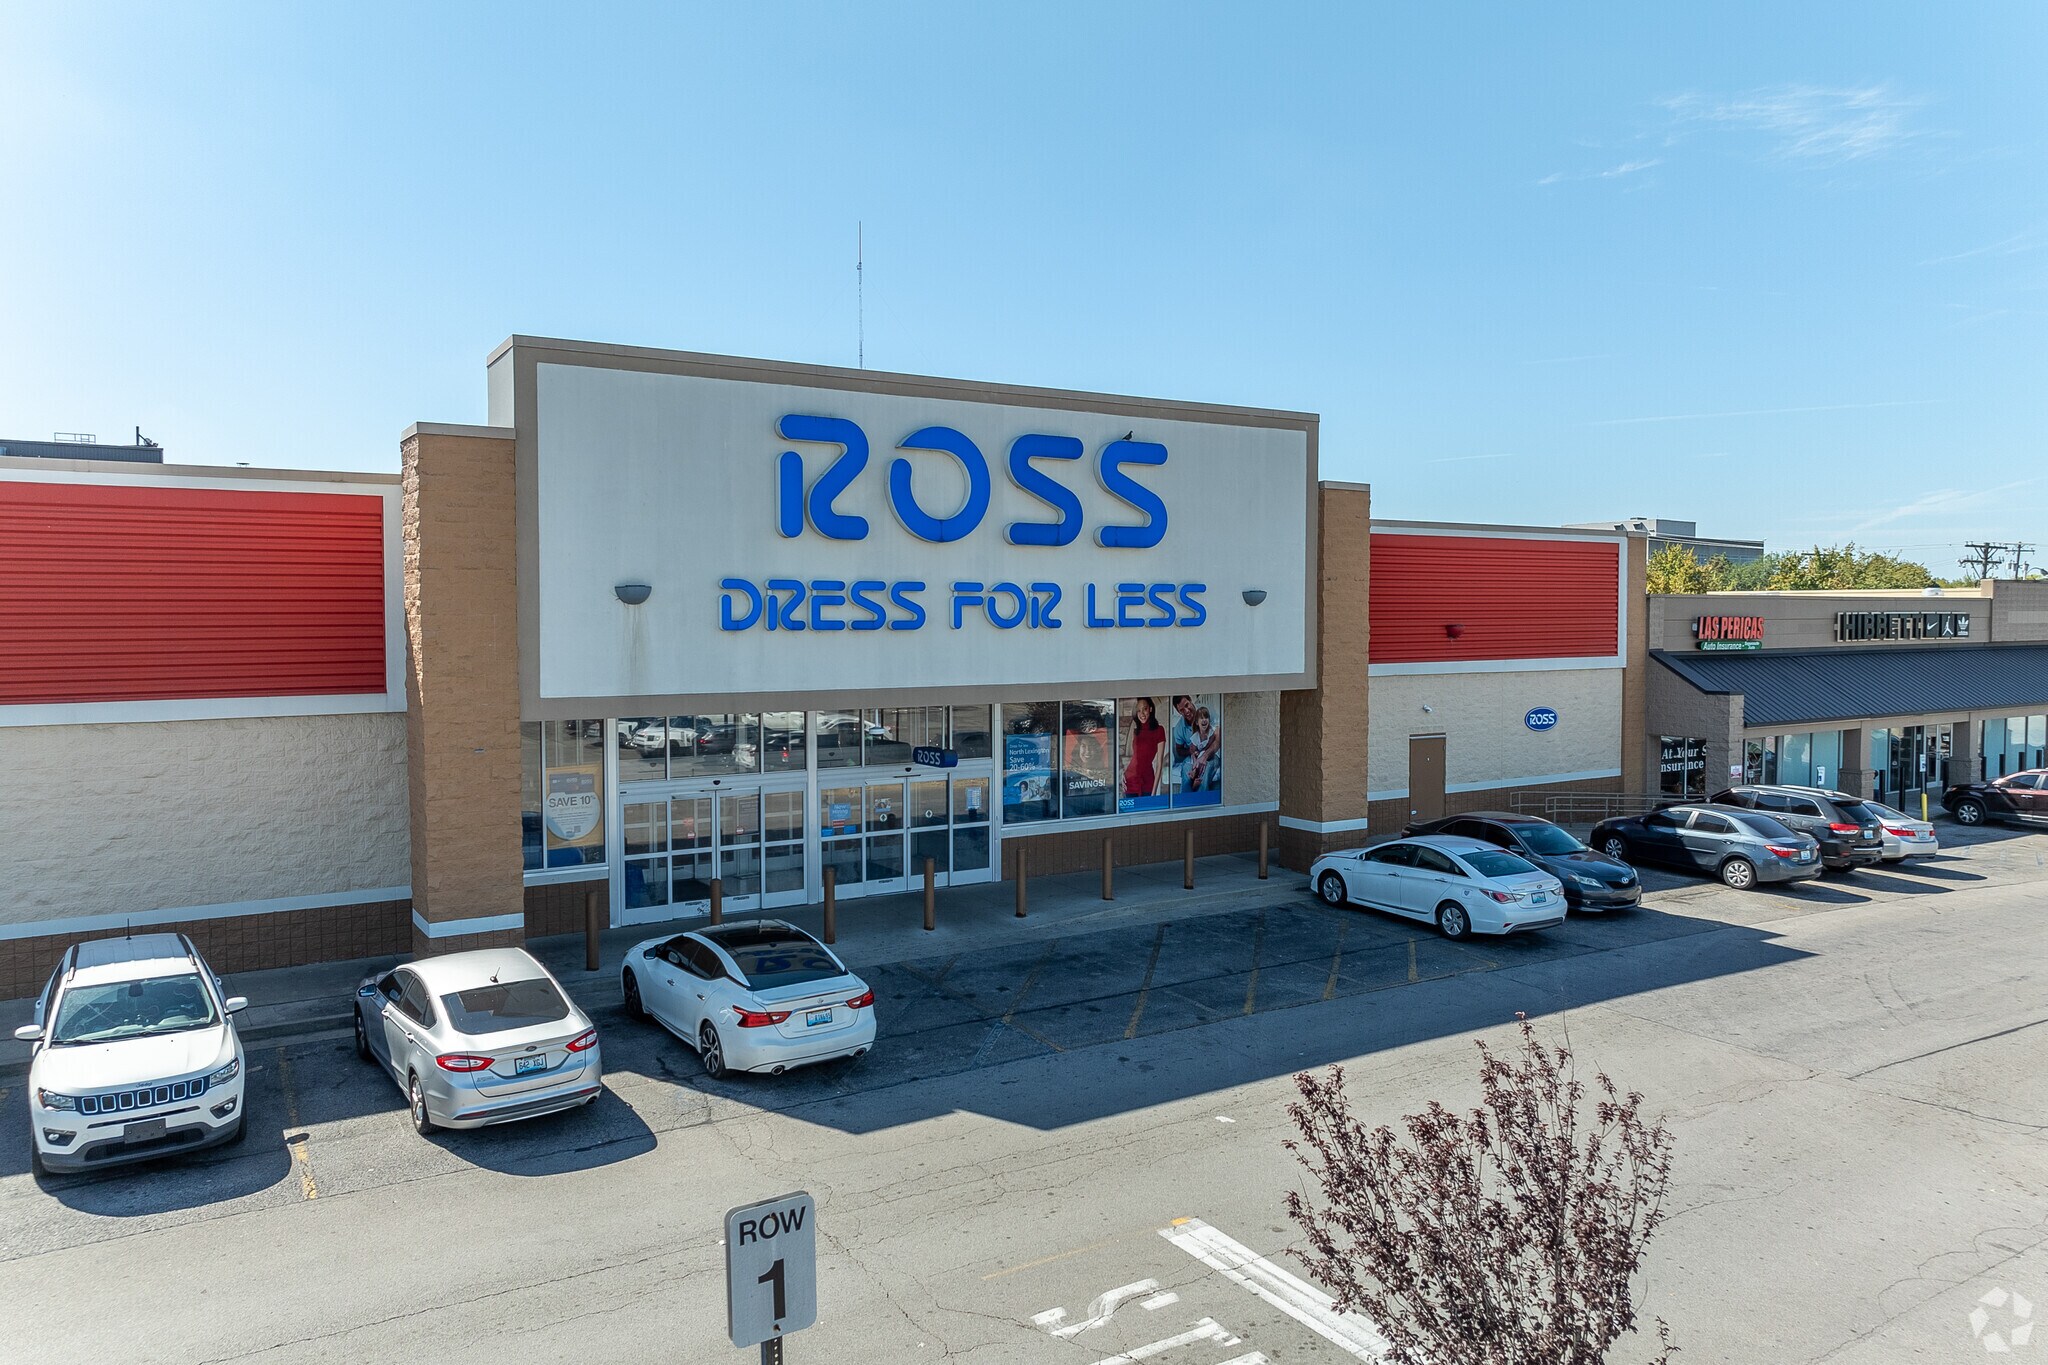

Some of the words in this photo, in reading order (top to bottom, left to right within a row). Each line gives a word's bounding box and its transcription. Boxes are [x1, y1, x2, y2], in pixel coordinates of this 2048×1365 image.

[776, 414, 1168, 548] ROSS
[718, 578, 926, 631] DRESS
[950, 581, 1062, 630] FOR
[1083, 583, 1207, 630] LESS
[1698, 616, 1719, 639] LAS
[1720, 616, 1765, 639] PERICAS
[1838, 612, 1922, 641] HIBBETT
[1703, 641, 1716, 650] Auto
[1530, 713, 1555, 725] ROSS
[917, 750, 941, 765] ROSS
[1661, 748, 1673, 760] At
[1661, 760, 1704, 773] nsurance
[1069, 779, 1106, 790] SAVINGS!
[548, 796, 577, 808] SAVE
[739, 1205, 806, 1247] ROW
[758, 1258, 786, 1321] 1
